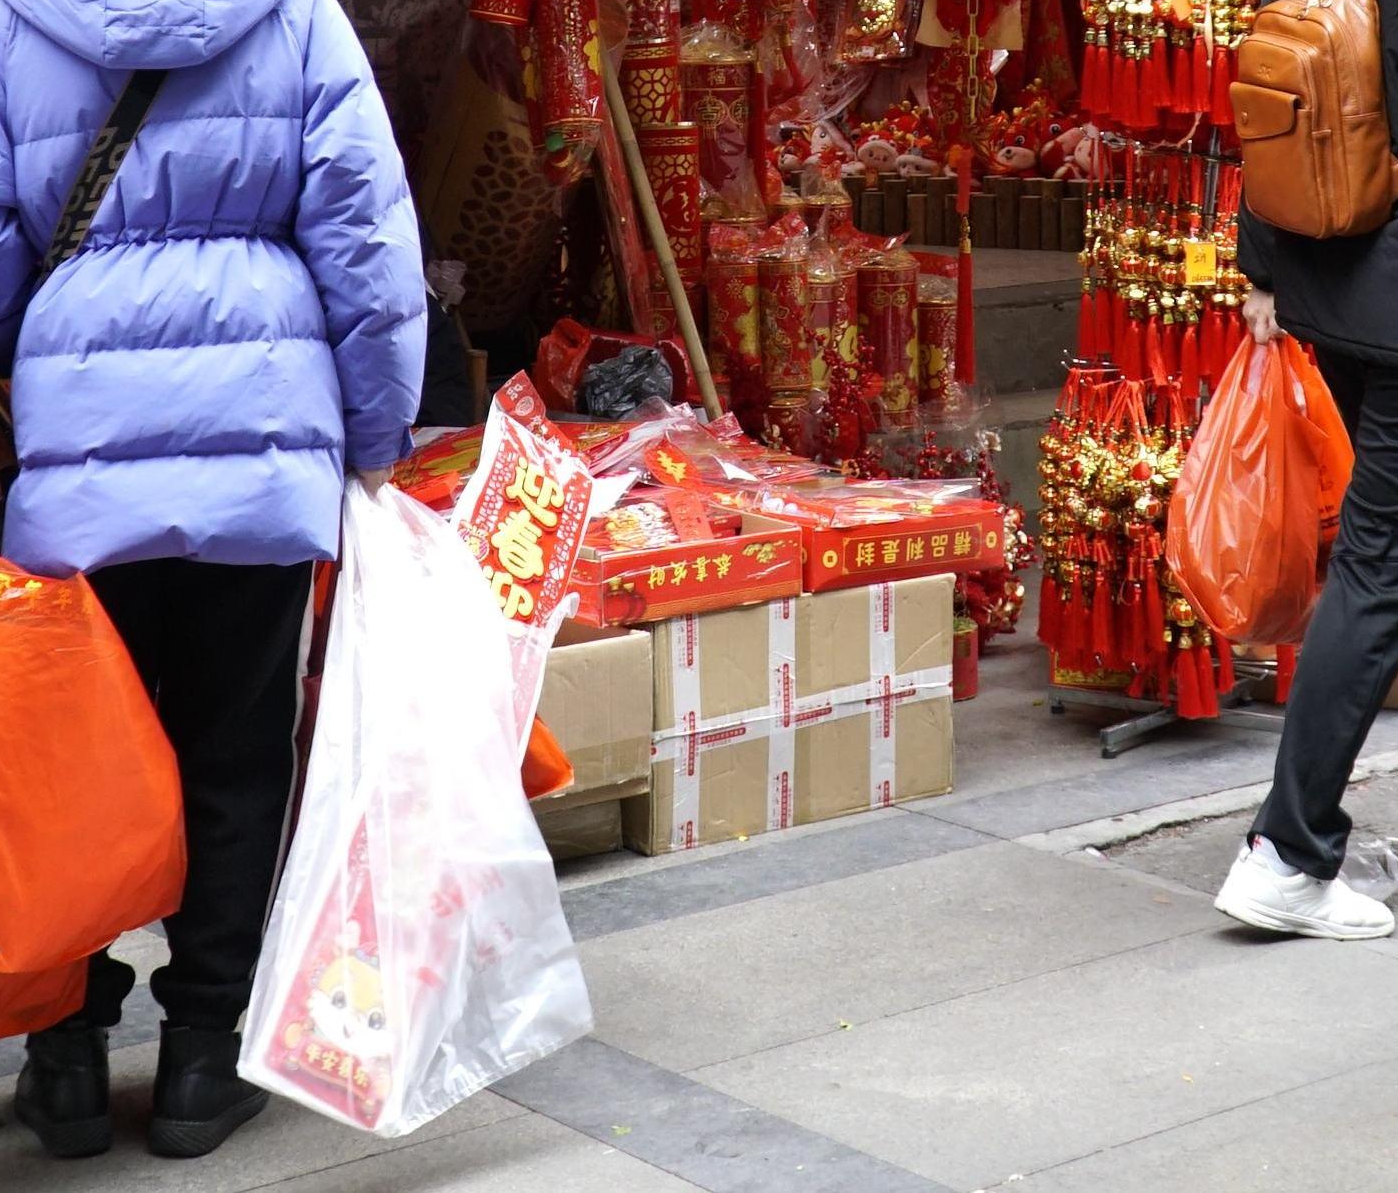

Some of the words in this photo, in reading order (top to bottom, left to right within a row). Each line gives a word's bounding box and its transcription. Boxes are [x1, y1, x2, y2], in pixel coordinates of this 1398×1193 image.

[855, 531, 972, 566] 精品利是封
